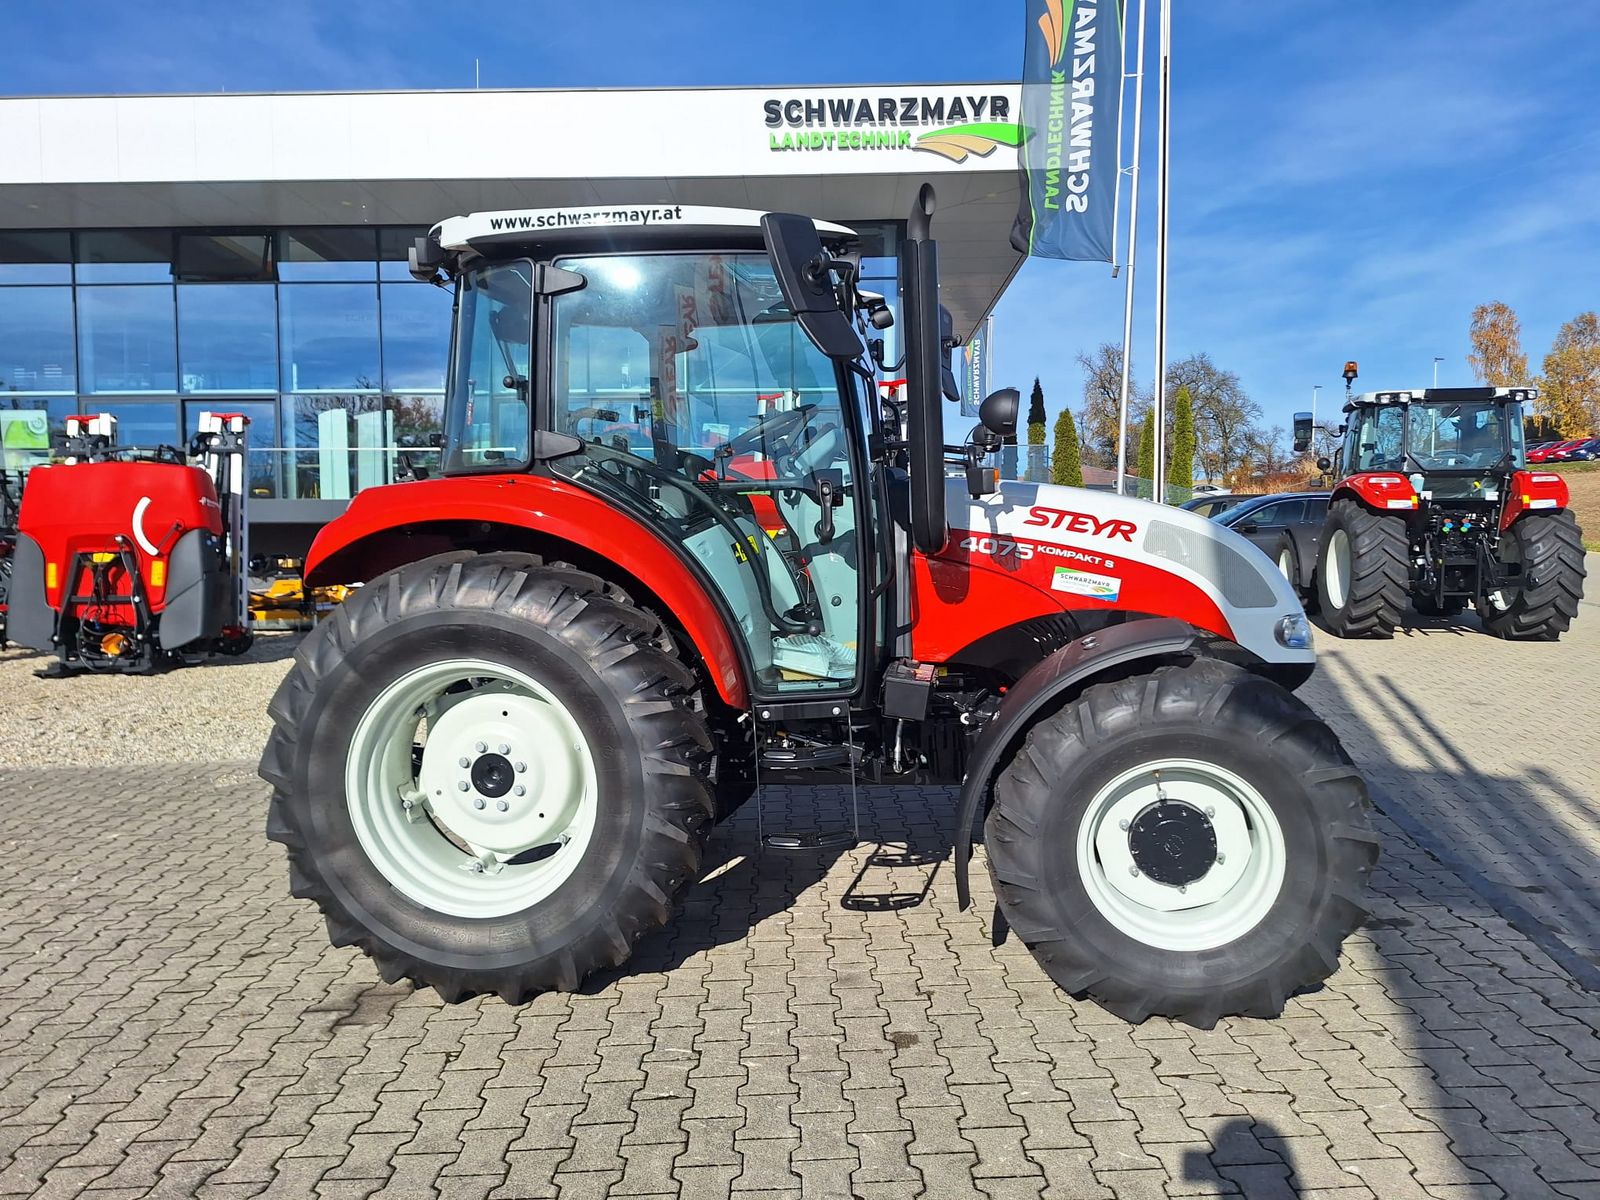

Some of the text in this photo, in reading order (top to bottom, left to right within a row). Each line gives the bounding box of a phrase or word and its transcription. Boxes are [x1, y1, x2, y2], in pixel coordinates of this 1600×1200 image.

[763, 95, 1010, 127] SCHWARZMAYR
[769, 130, 912, 151] LANDTECHNIK
[490, 205, 683, 230] www.schwarzmayr.at
[1023, 506, 1138, 543] STEYR
[960, 536, 1115, 569] 4075 KOMPAKT S
[1060, 573, 1111, 587] SCHWARZMAYR
